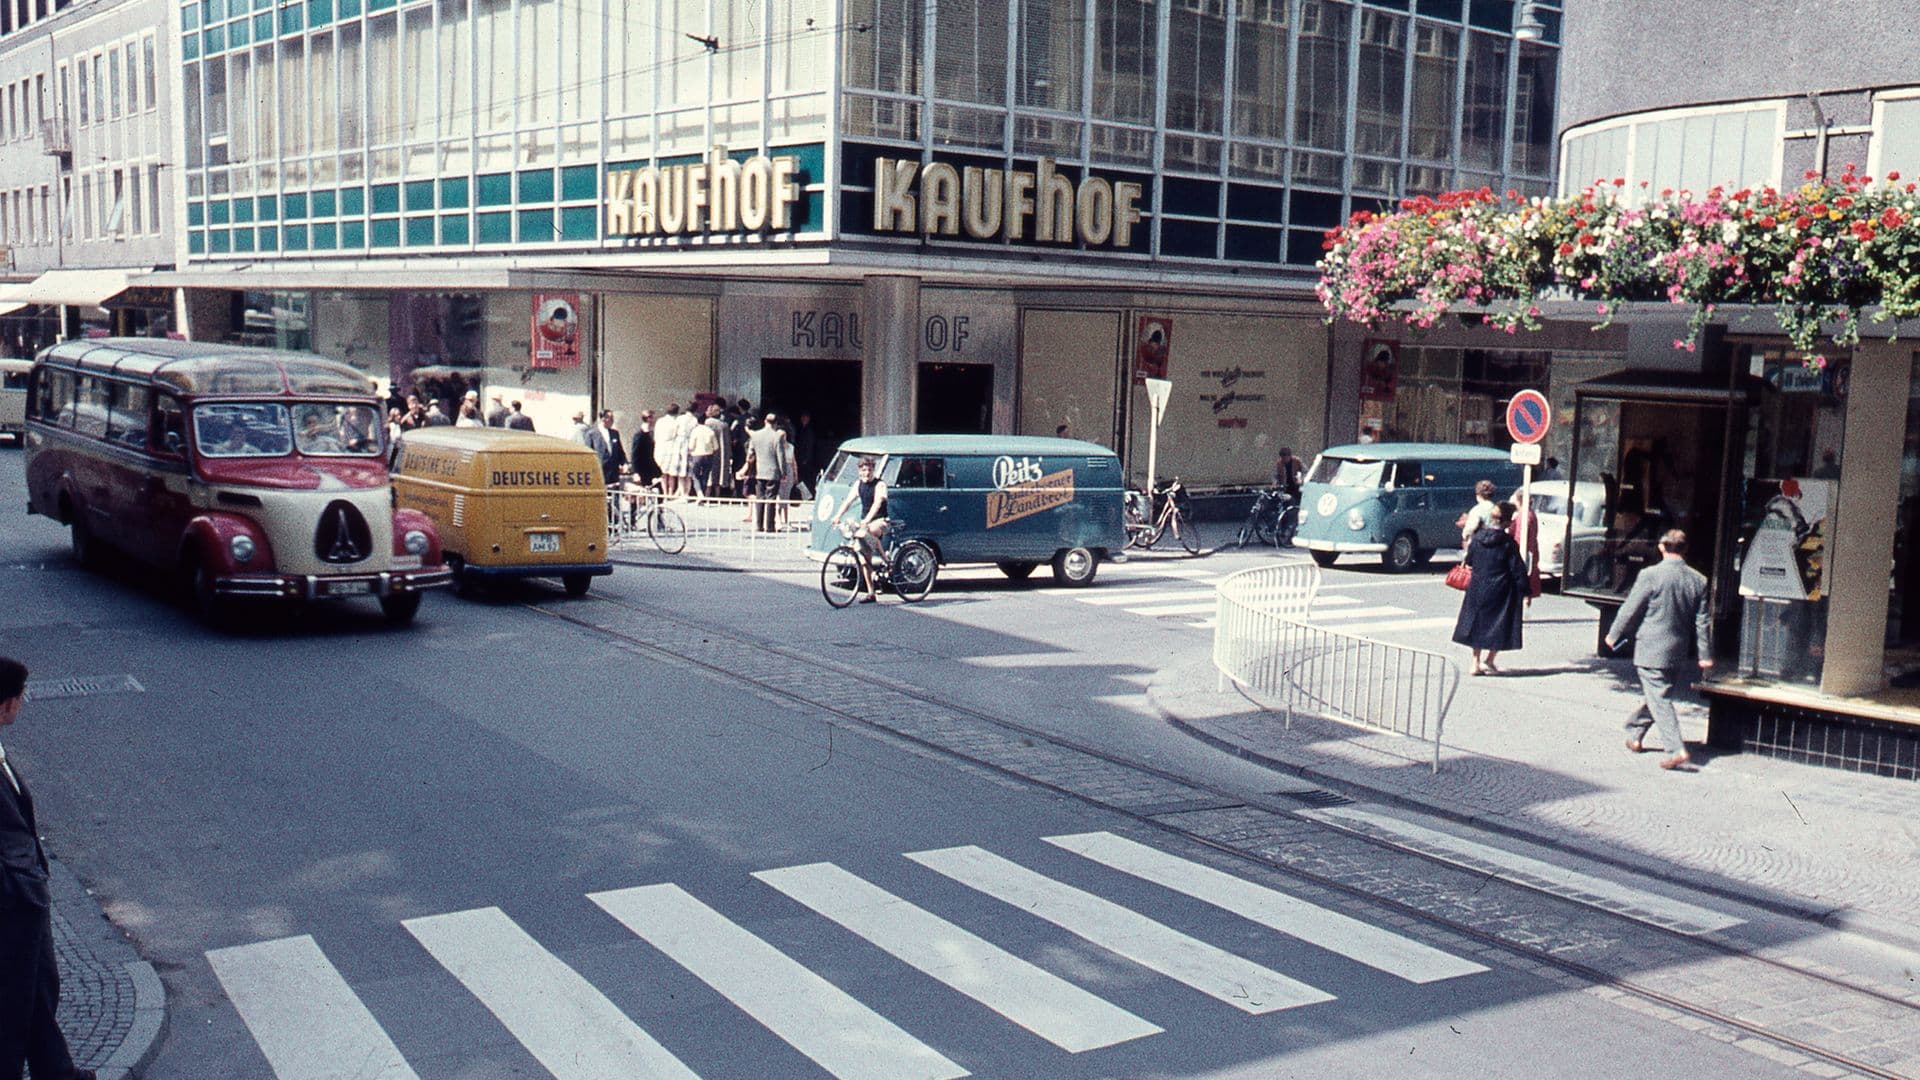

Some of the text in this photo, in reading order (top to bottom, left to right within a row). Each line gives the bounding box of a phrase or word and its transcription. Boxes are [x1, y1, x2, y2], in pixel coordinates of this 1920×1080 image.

[791, 310, 970, 352] KAUOF
[441, 457, 457, 477] SEE
[493, 471, 592, 486] DEUTSCHE SEE
